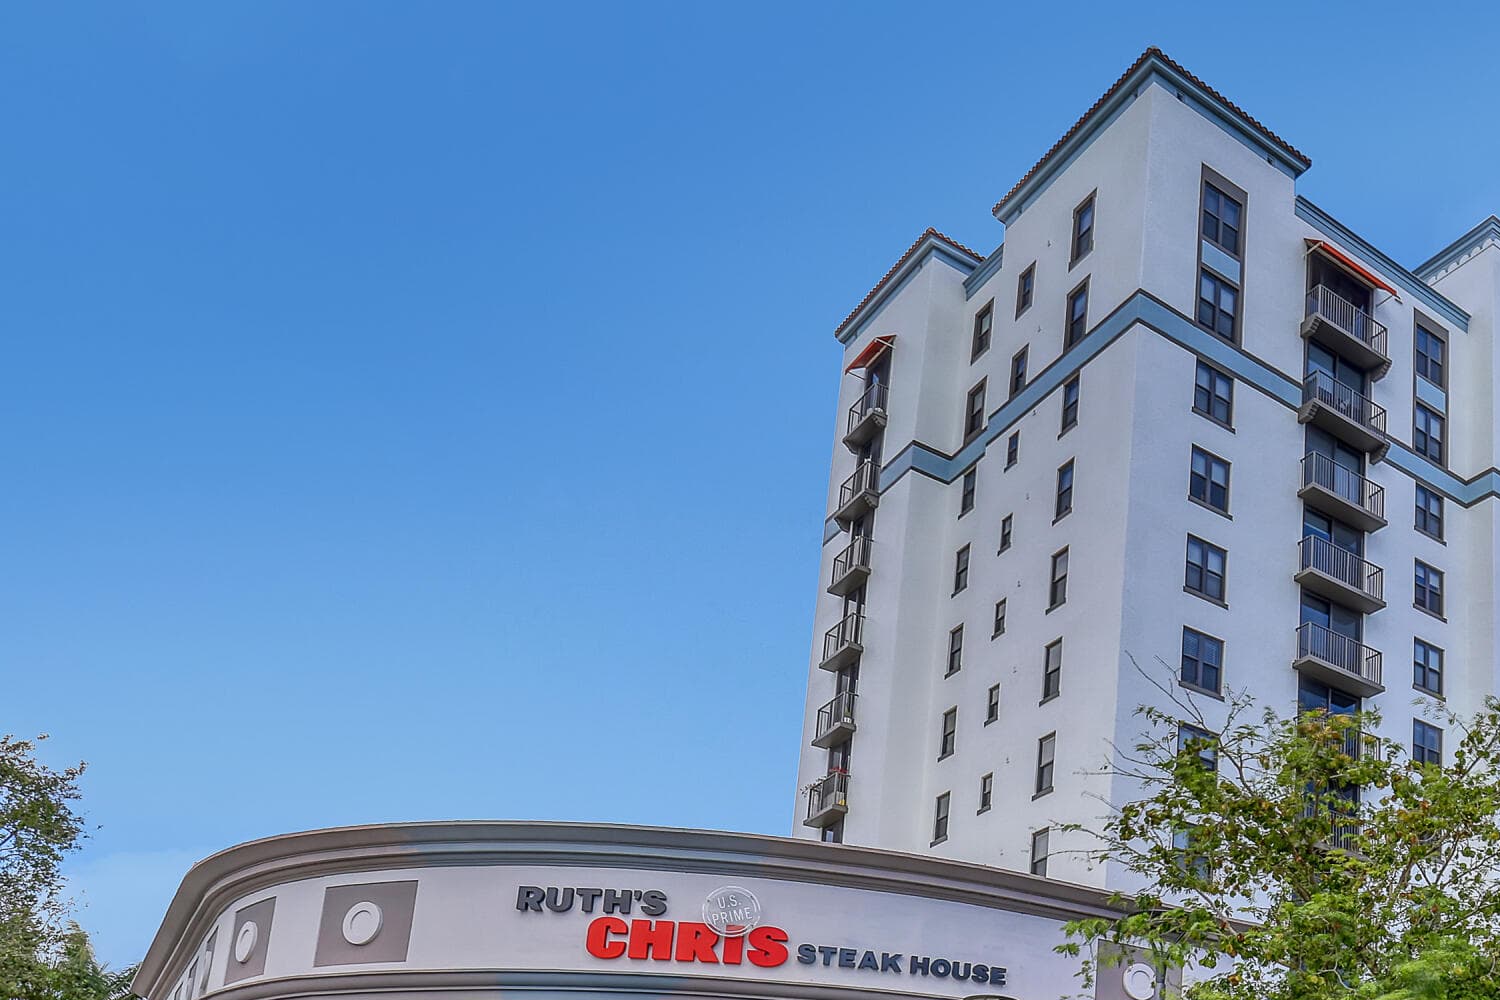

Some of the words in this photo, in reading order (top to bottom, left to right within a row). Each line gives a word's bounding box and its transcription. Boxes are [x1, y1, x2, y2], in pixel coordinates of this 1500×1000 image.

[516, 885, 668, 916] RUTH'S
[711, 906, 753, 926] PRIME
[717, 894, 742, 909] U.S.
[587, 916, 789, 968] CHRIS
[797, 943, 902, 973] STEAK
[909, 955, 1008, 986] HOUSE
